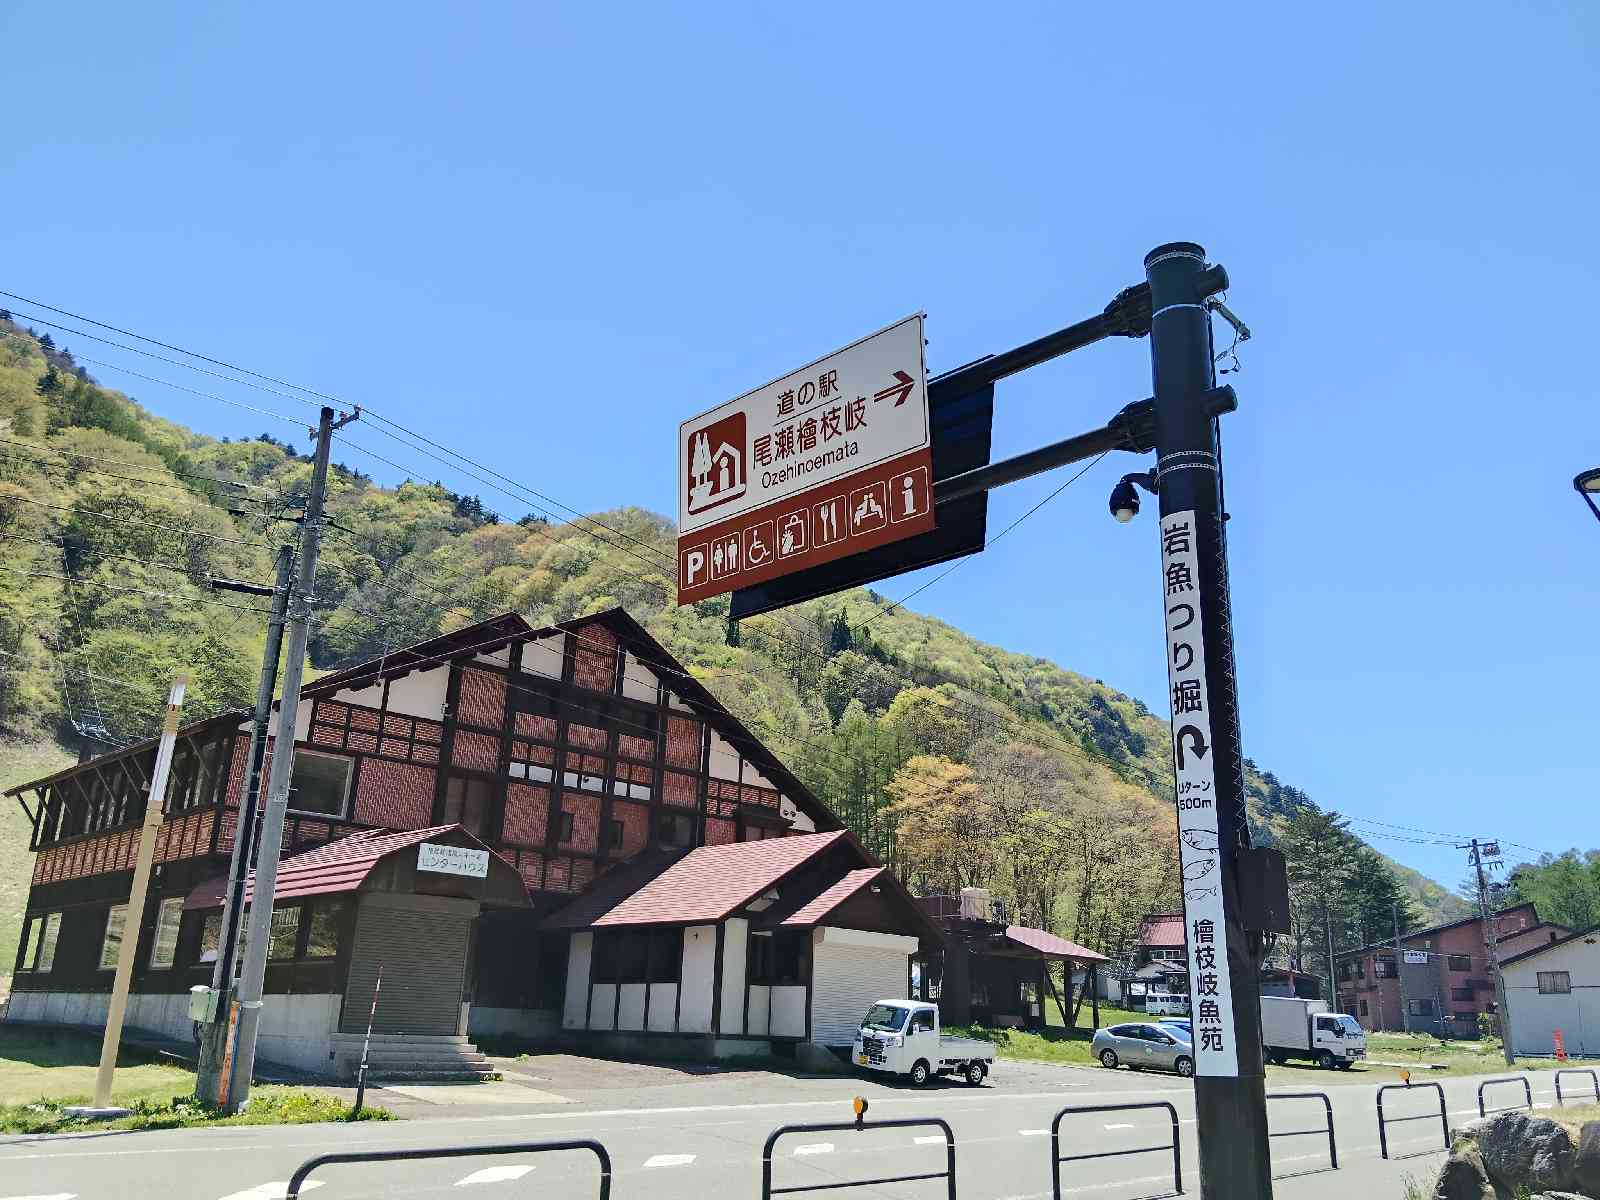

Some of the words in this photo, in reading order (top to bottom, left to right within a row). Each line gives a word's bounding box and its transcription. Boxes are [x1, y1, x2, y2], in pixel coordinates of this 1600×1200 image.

[776, 369, 839, 418] 道の駅
[753, 395, 868, 471] 尾瀬檜枝岐
[761, 440, 859, 489] Ozehinoemata
[687, 551, 704, 585] P
[1163, 521, 1203, 715] 岩魚つり堀
[1178, 779, 1211, 794] Uターン
[1179, 797, 1212, 811] 500m
[1192, 918, 1224, 1052] 檜枝岐魚苑
